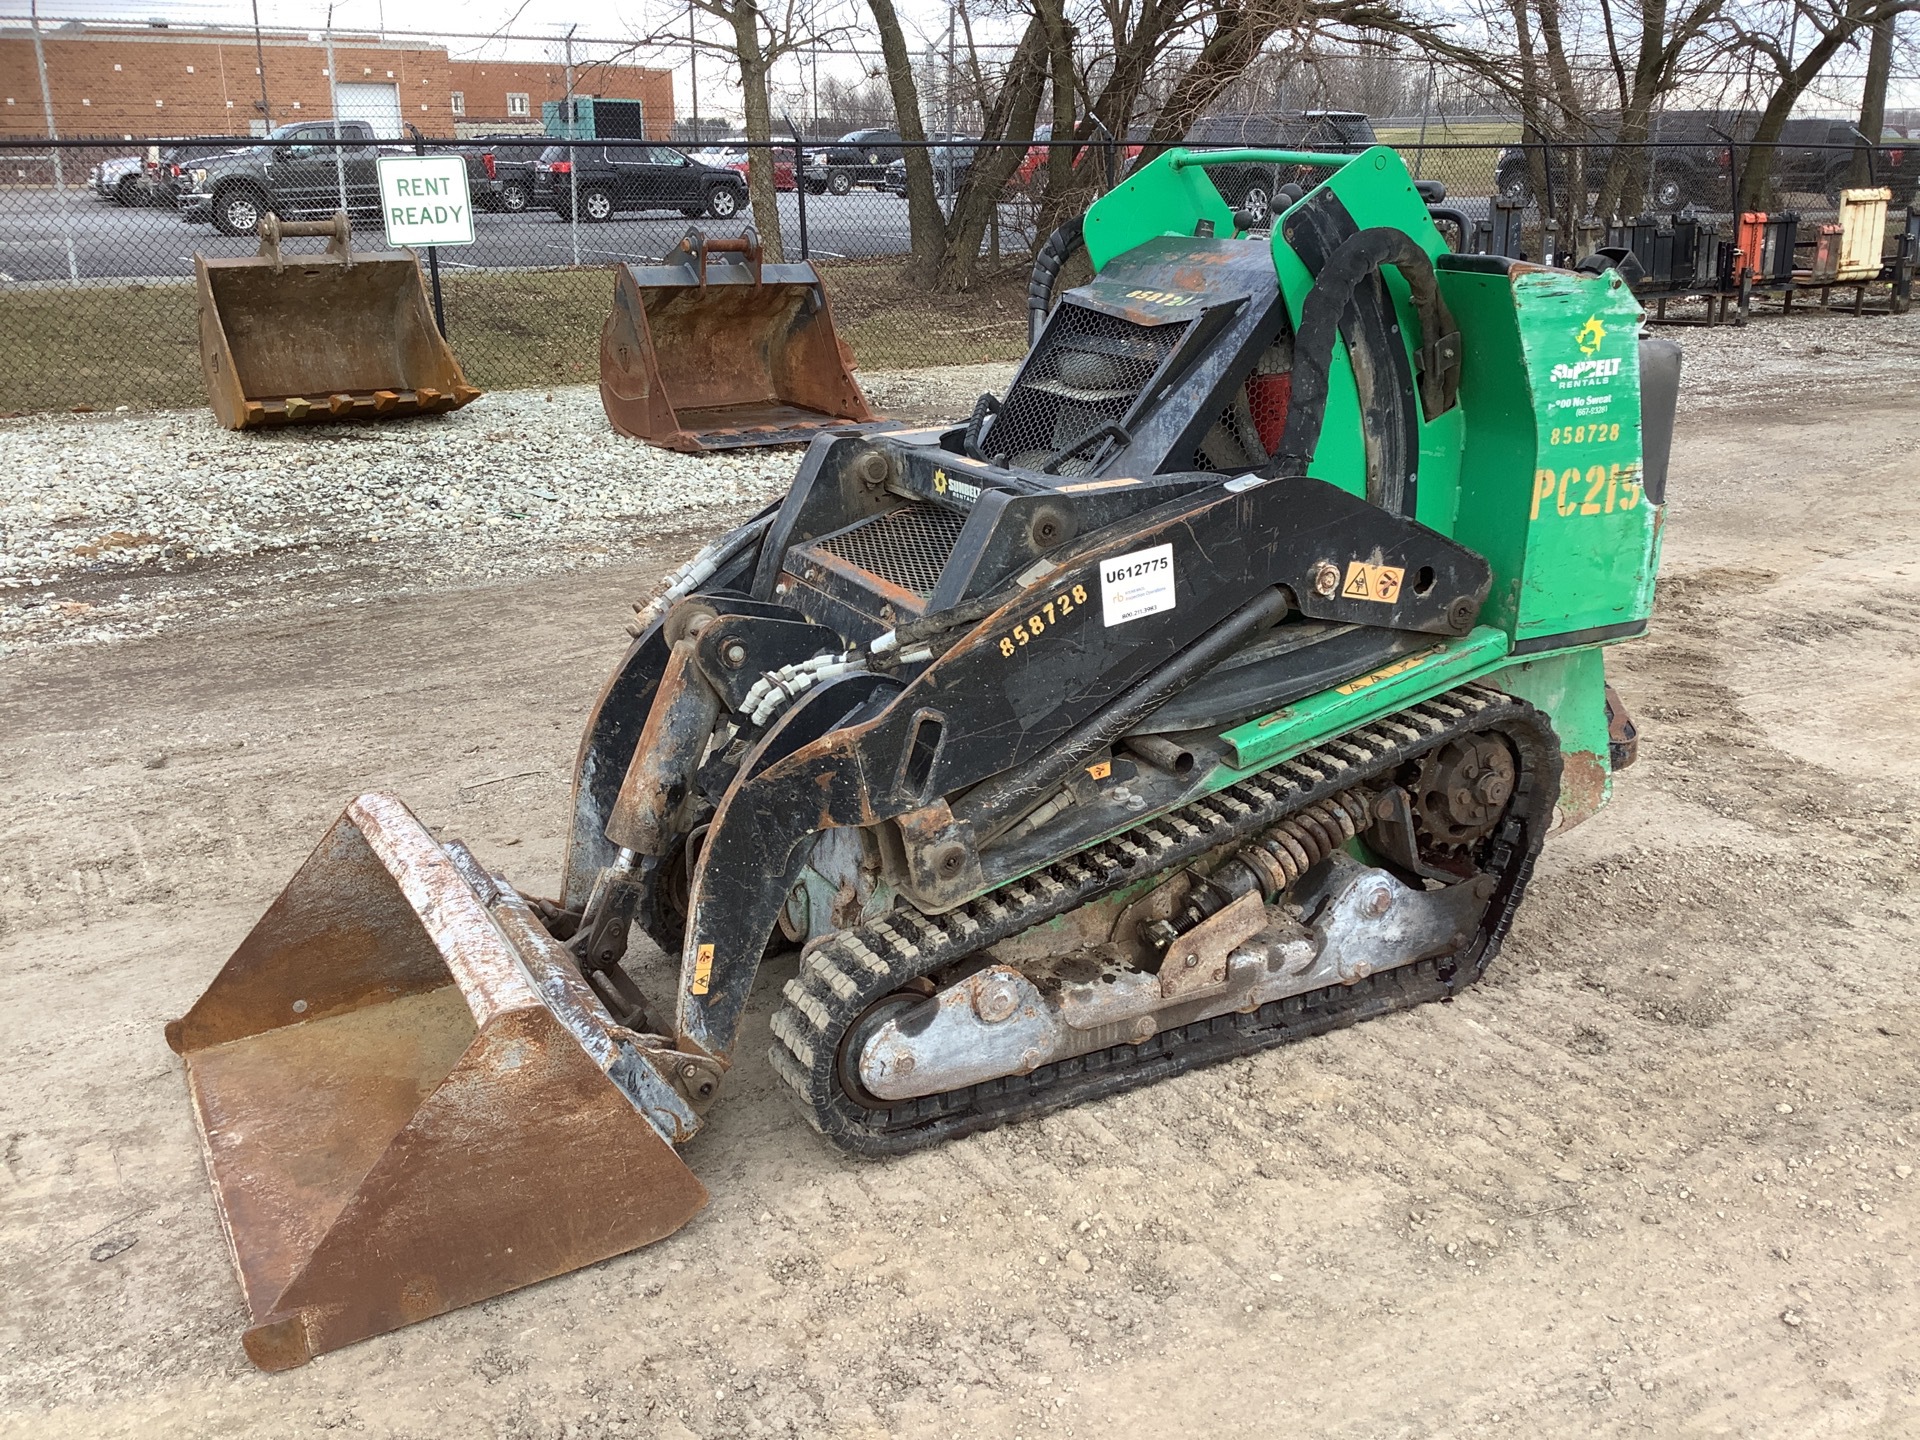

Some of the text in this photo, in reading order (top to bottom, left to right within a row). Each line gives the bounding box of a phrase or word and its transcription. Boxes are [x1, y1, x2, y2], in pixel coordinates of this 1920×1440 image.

[396, 177, 450, 197] RENT
[391, 205, 462, 226] READY
[1558, 377, 1609, 390] RENTALS
[1572, 396, 1585, 407] No
[1586, 394, 1612, 405] Sweat
[1550, 423, 1620, 445] 858728
[1530, 463, 1640, 520] PC215
[1106, 557, 1168, 583] U612775
[999, 584, 1088, 657] 858728
